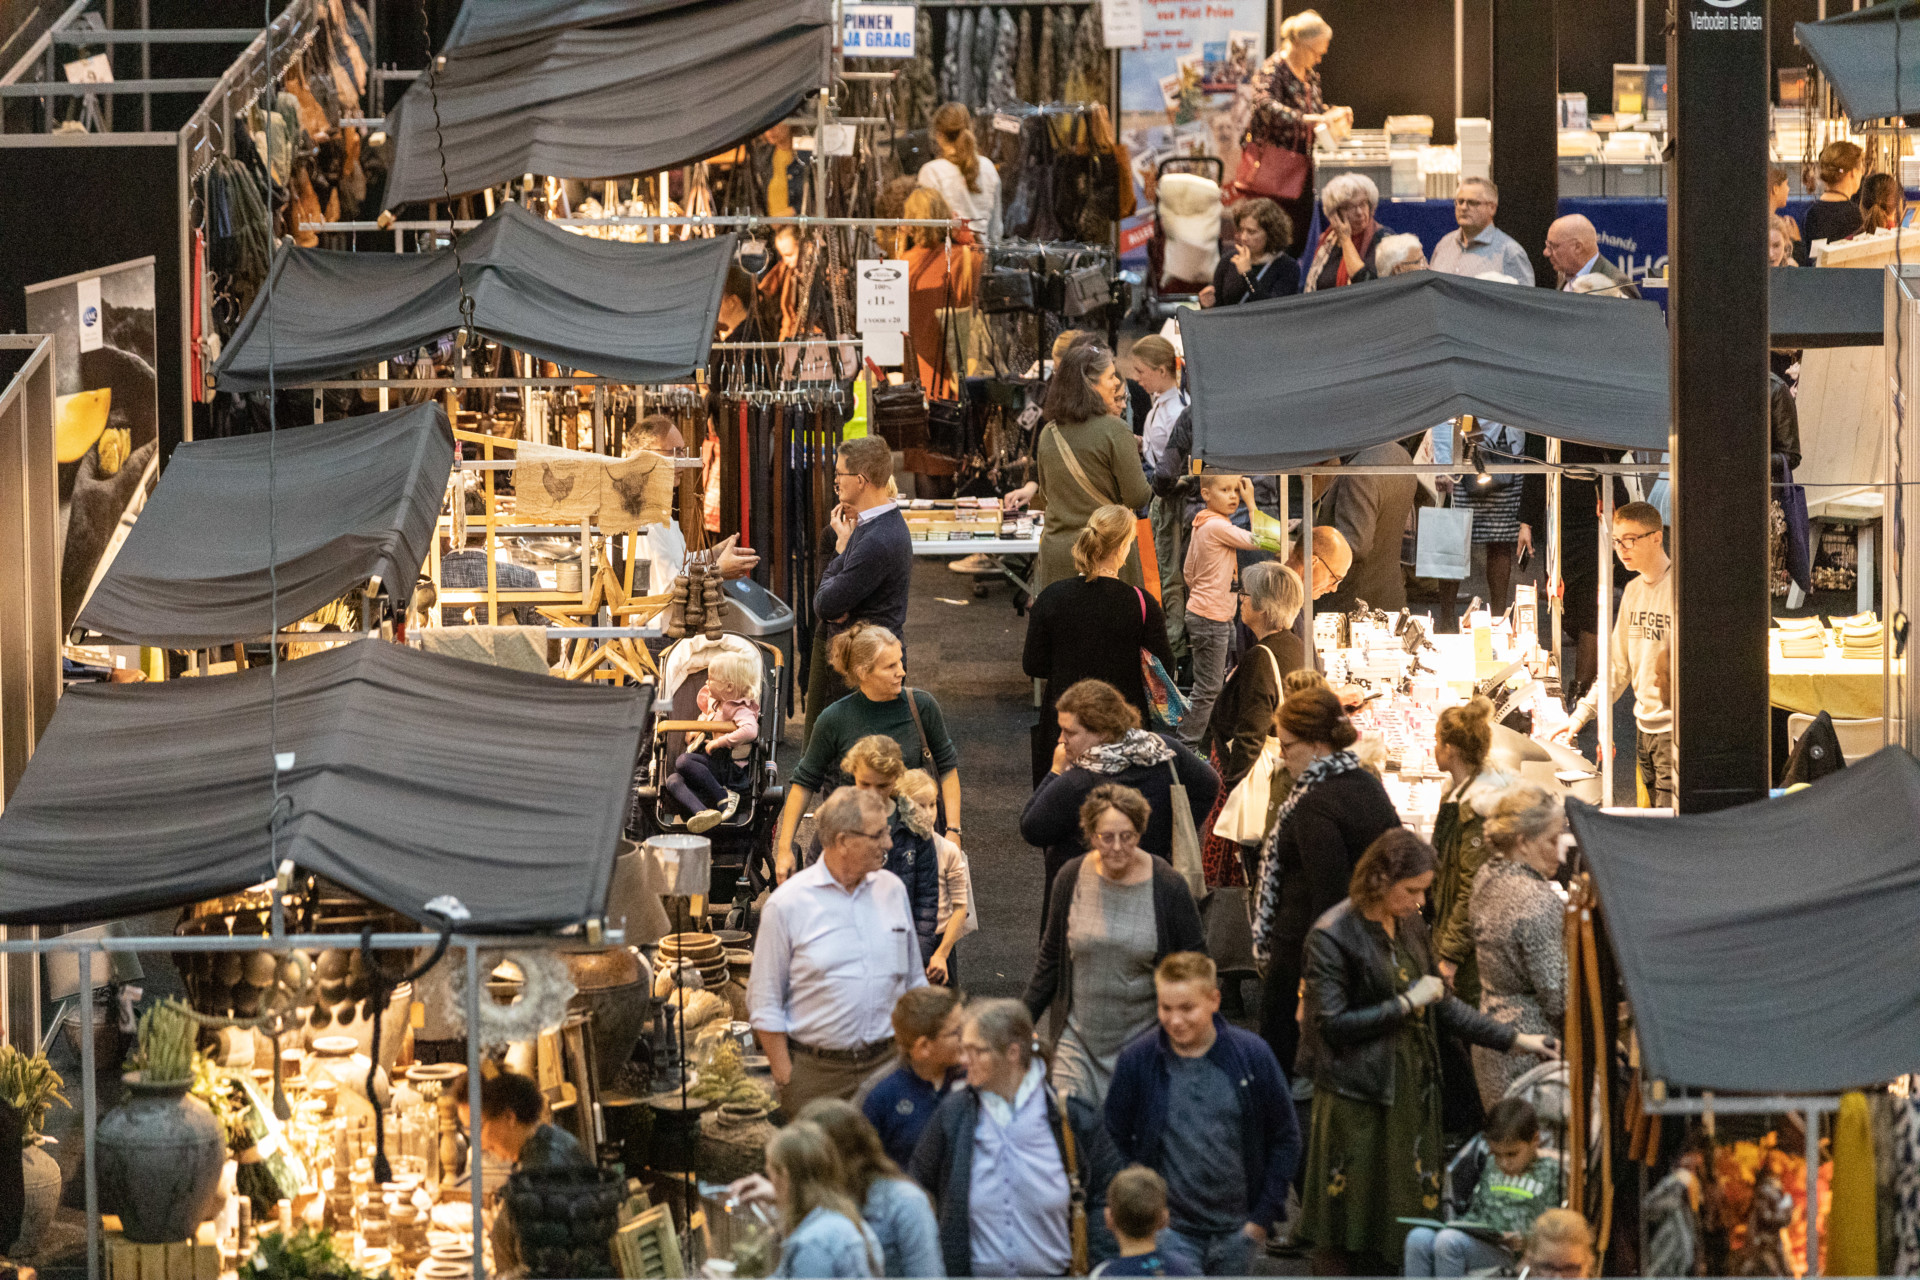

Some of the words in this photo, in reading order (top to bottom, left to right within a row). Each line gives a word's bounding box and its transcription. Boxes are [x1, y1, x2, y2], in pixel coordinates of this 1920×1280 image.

[844, 13, 893, 30] PINNEN
[1689, 11, 1729, 31] Verboden
[1730, 13, 1739, 30] te
[1739, 11, 1763, 31] roken
[844, 31, 861, 47] JA
[866, 31, 911, 47] GRAAG
